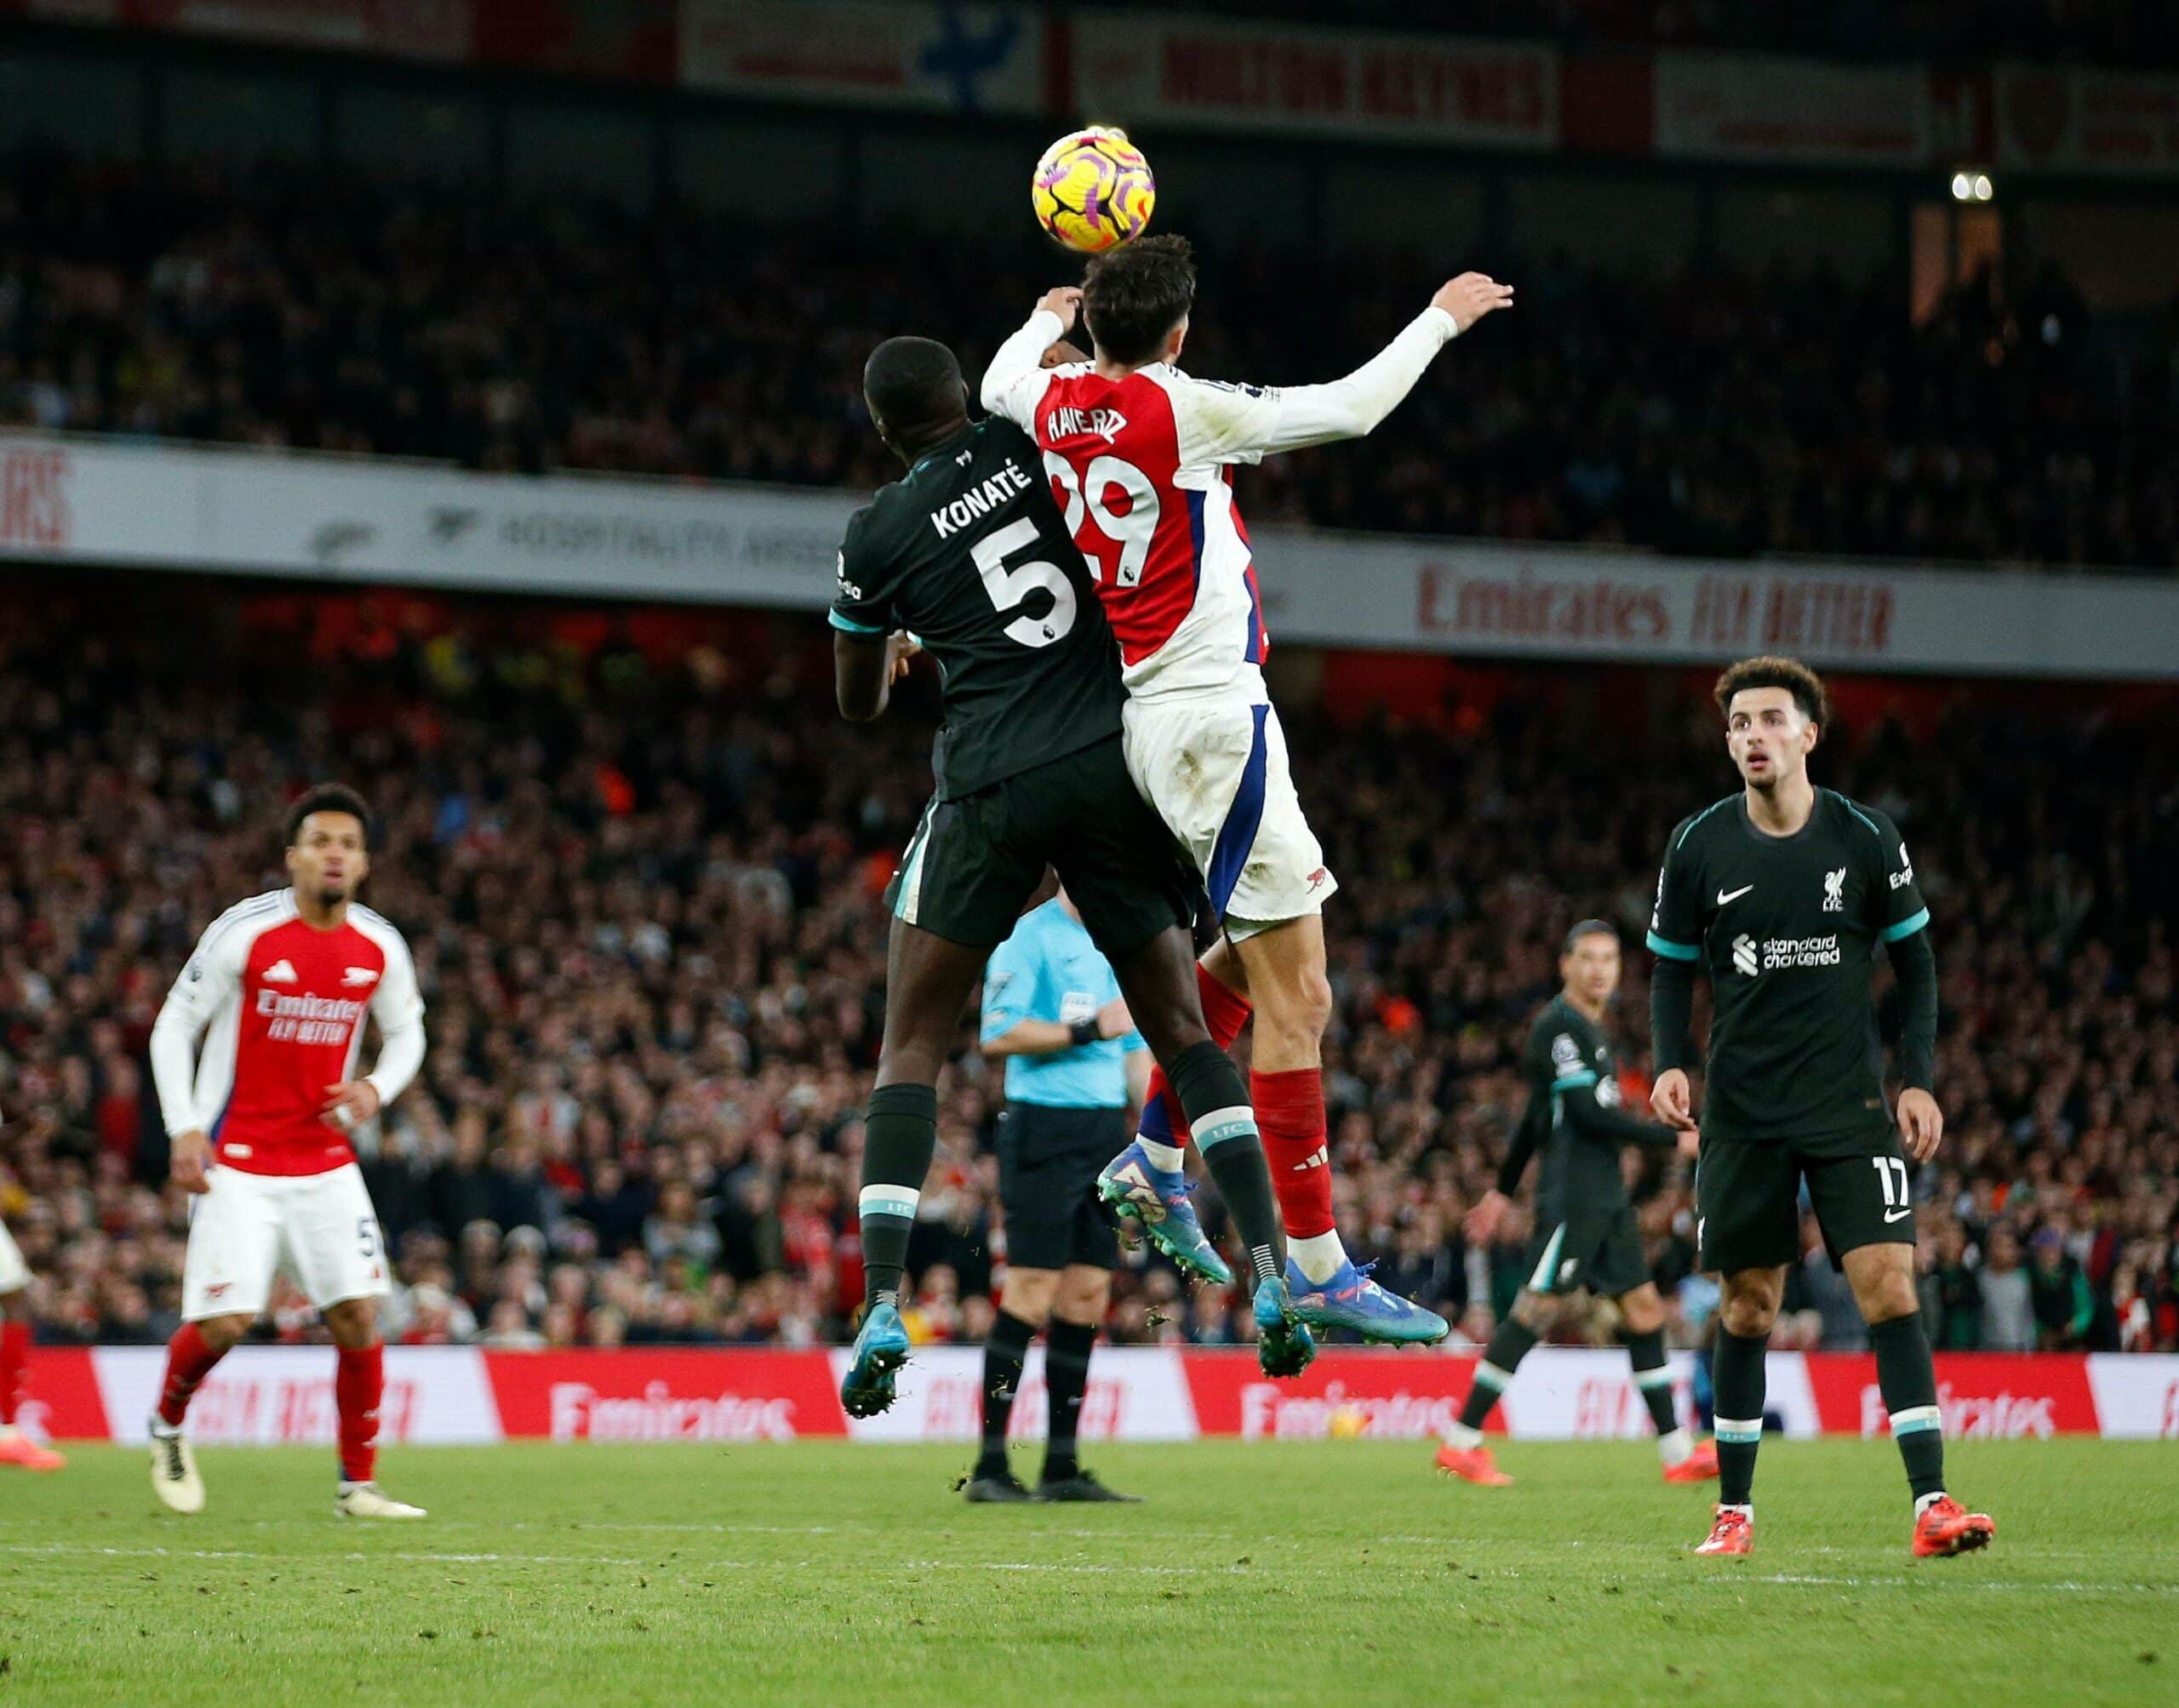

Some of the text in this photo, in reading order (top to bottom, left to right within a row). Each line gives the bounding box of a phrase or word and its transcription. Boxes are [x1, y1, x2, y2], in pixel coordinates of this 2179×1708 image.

[930, 457, 1032, 539] KONATÉ
[1043, 449, 1160, 587] 29
[970, 516, 1078, 648] 5
[1416, 560, 1667, 642] Emirates
[1822, 897, 1845, 912] LFC
[1762, 934, 1836, 955] standard
[1764, 947, 1840, 968] chartered
[1212, 1122, 1244, 1139] LFC
[1873, 1157, 1908, 1207] 17
[549, 1379, 798, 1442] Emirates
